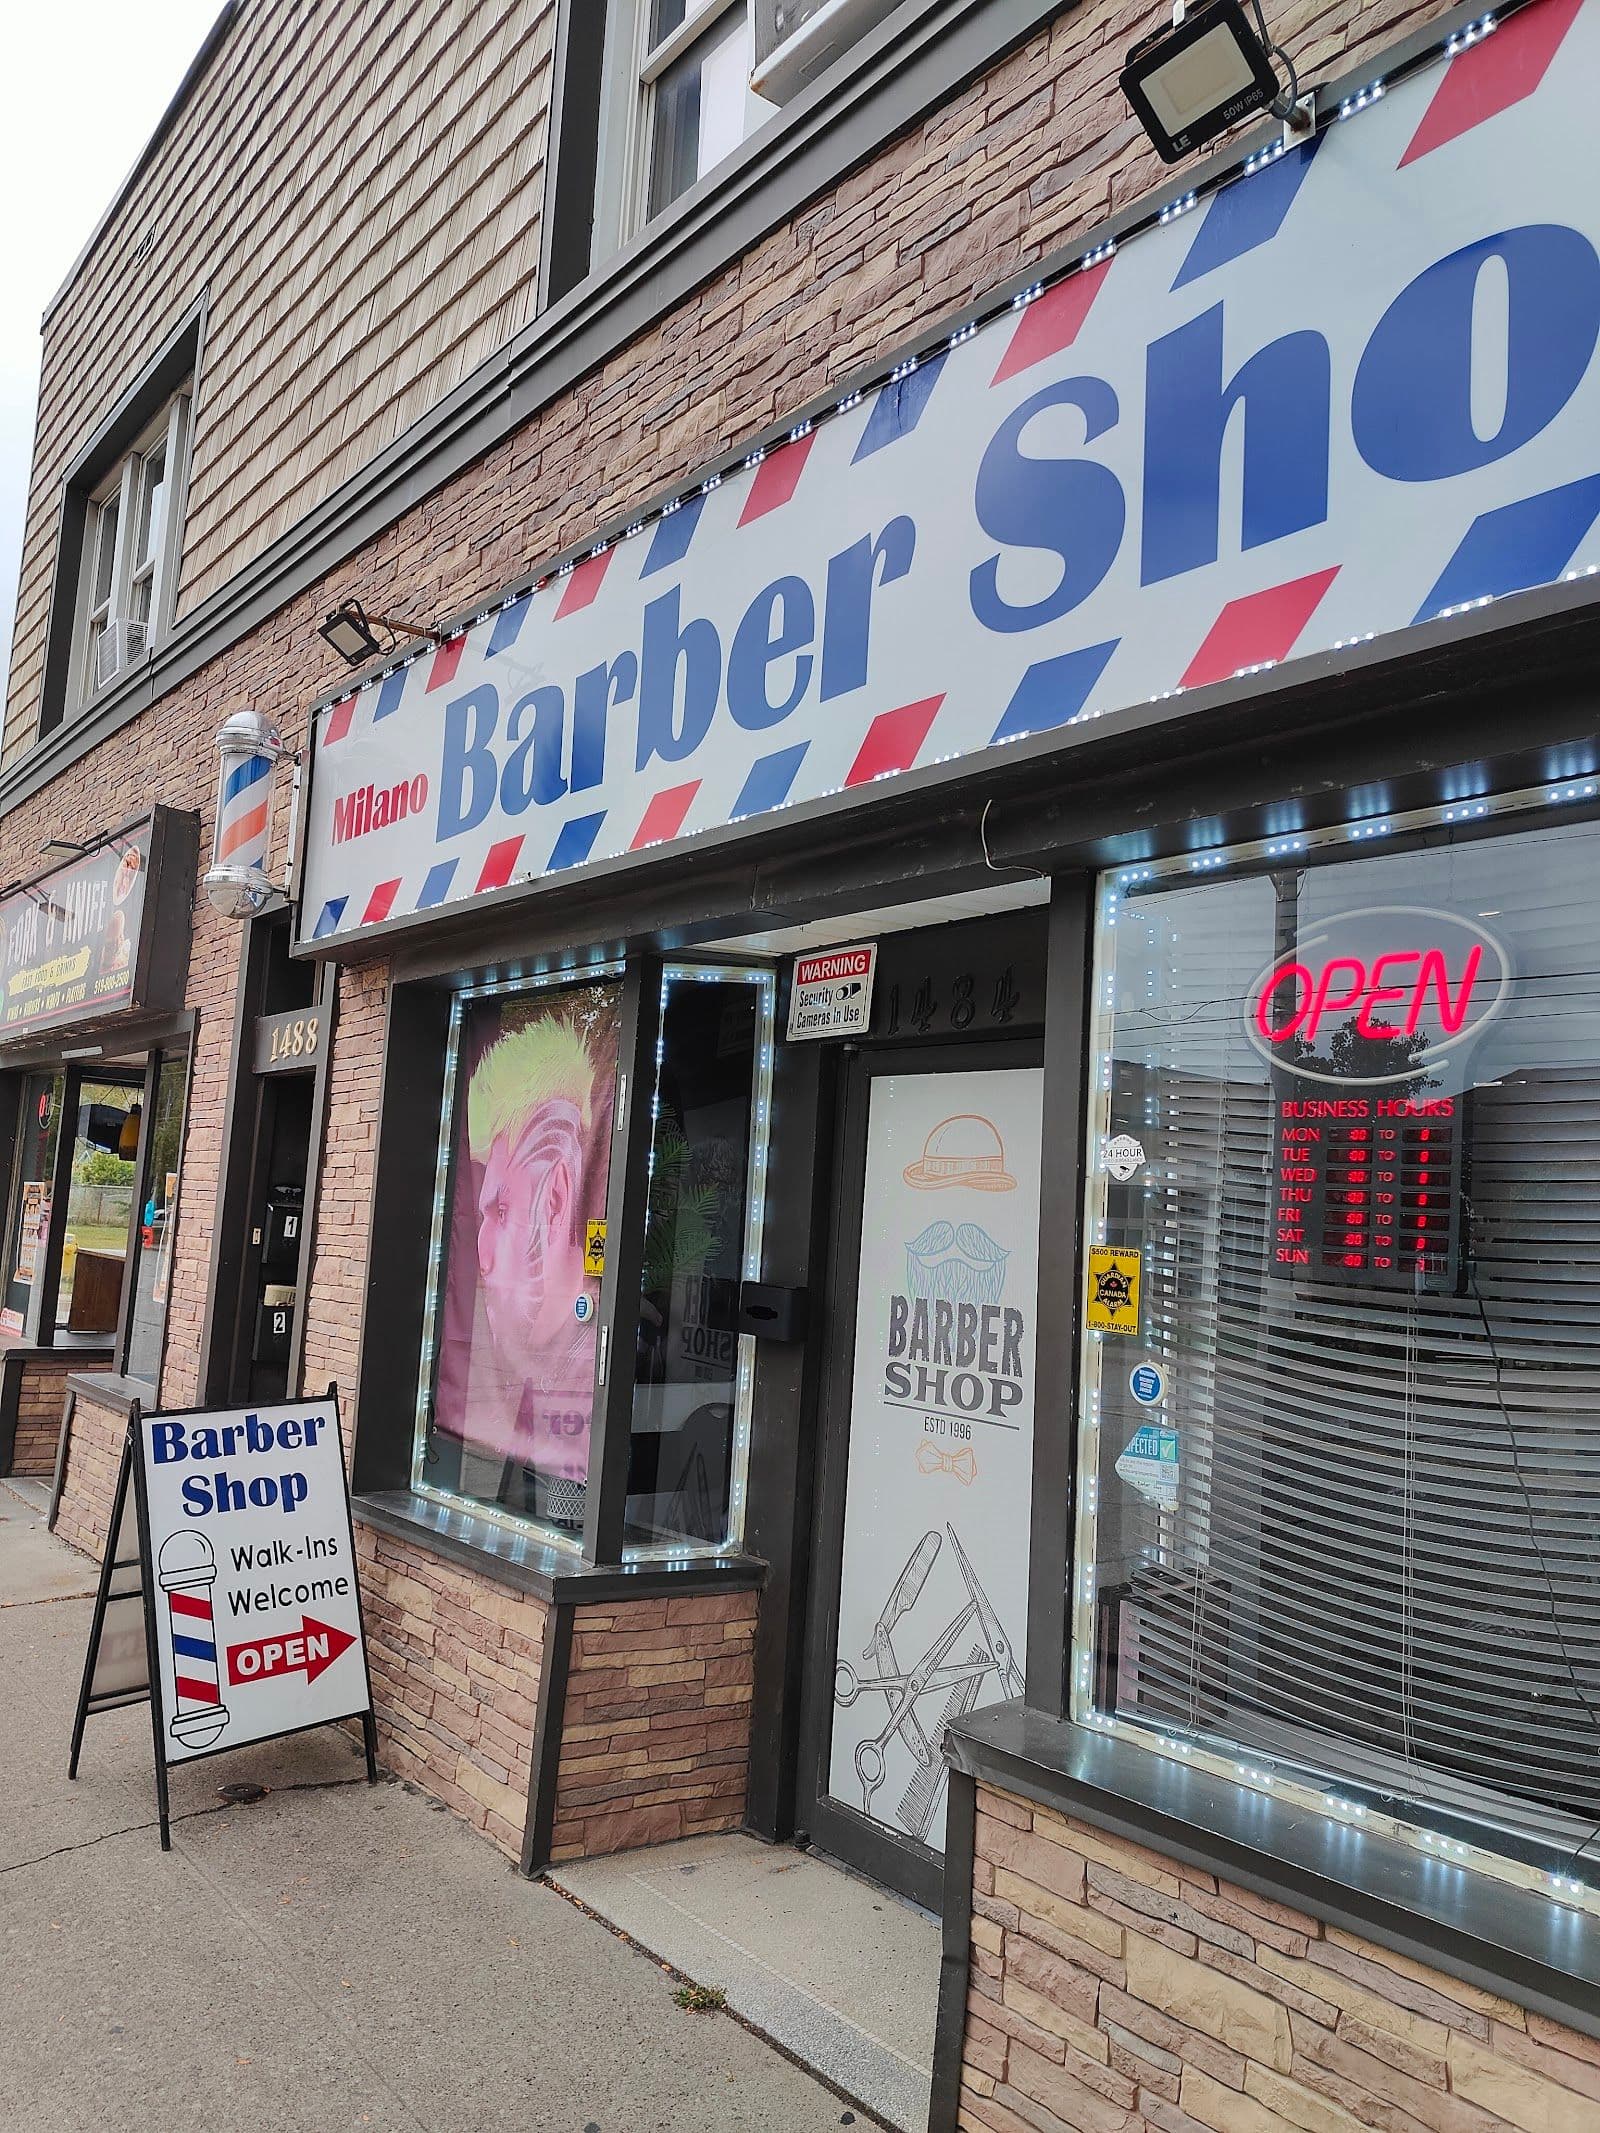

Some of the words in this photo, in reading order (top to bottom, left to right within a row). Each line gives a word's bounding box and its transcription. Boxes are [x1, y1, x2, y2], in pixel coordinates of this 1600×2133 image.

[1222, 100, 1244, 120] 50W
[1244, 89, 1264, 106] IP65
[1172, 135, 1191, 152] LE
[331, 774, 428, 847] Milano
[436, 515, 916, 843] Barber
[7, 900, 40, 966] FORK
[62, 880, 108, 944] KNIFE
[801, 954, 866, 982] WARNING
[800, 986, 834, 1008] Security
[888, 963, 1020, 1036] 1484
[1257, 944, 1482, 1043] OPEN
[797, 1011, 831, 1029] Cameras
[833, 1006, 841, 1024] In
[843, 1005, 860, 1022] Use
[269, 1017, 319, 1062] 1488
[1281, 1100, 1370, 1118] BUSINESS
[1377, 1098, 1455, 1117] HOURS
[1281, 1128, 1321, 1142] MON
[1378, 1129, 1395, 1140] TO
[1103, 1149, 1113, 1158] 24
[1115, 1148, 1142, 1158] HOUR
[1281, 1148, 1311, 1162] TUE
[1378, 1150, 1396, 1161] TO
[1280, 1168, 1318, 1182] WED
[1377, 1171, 1395, 1182] TO
[1279, 1188, 1313, 1202] THU
[1376, 1193, 1394, 1204] TO
[287, 1217, 296, 1236] 1
[1277, 1208, 1302, 1222] FRI
[1375, 1214, 1393, 1225] TO
[1276, 1228, 1305, 1242] SAT
[1375, 1235, 1392, 1246] TO
[1091, 1248, 1109, 1256] $500
[1110, 1250, 1139, 1258] REWARD
[1276, 1248, 1310, 1264] SUN
[1374, 1257, 1391, 1268] TO
[1101, 1272, 1127, 1289] GUARDIAN
[1100, 1290, 1126, 1298] CANADA
[1103, 1299, 1123, 1308] ALARM
[275, 1314, 283, 1332] 2
[1088, 1321, 1136, 1333] 1-800-STAY-OUT
[888, 1295, 1025, 1378] BARBER
[884, 1361, 1024, 1419] SHOP
[151, 1413, 326, 1465] Barber
[923, 1416, 946, 1436] ESTD
[949, 1420, 972, 1441] 1996
[181, 1471, 309, 1518] Shop
[230, 1535, 338, 1573] Walk-Ins
[227, 1575, 349, 1617] Welcome
[236, 1633, 330, 1677] OPEN
